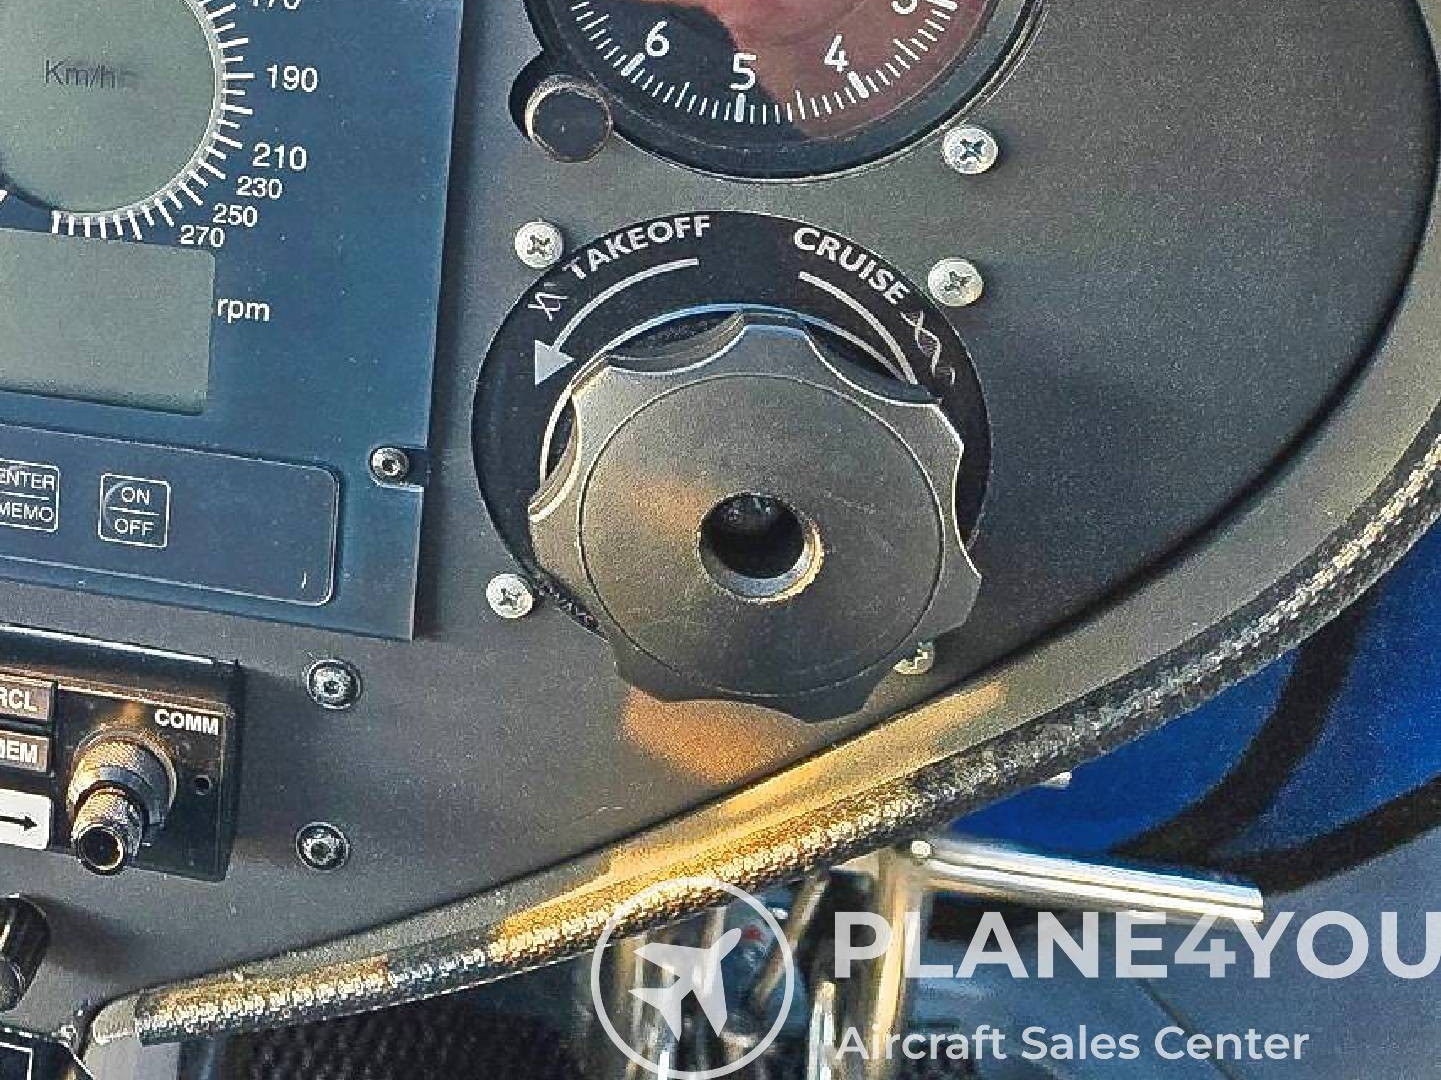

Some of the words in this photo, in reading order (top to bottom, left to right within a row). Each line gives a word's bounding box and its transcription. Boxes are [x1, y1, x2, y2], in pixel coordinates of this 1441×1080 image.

[645, 20, 671, 58] 6
[824, 34, 849, 72] 4
[44, 58, 118, 91] Km/h
[266, 65, 320, 93] 190
[729, 53, 757, 92] 5
[252, 144, 309, 171] 210
[236, 176, 284, 200] 230
[213, 204, 259, 229] 250
[179, 224, 226, 248] 270
[562, 213, 712, 280] TAKEOFF
[792, 226, 911, 305] CRUISE
[216, 297, 271, 323] rpm
[120, 486, 152, 505] ON
[113, 518, 156, 536] OFF
[153, 707, 220, 737] COMM
